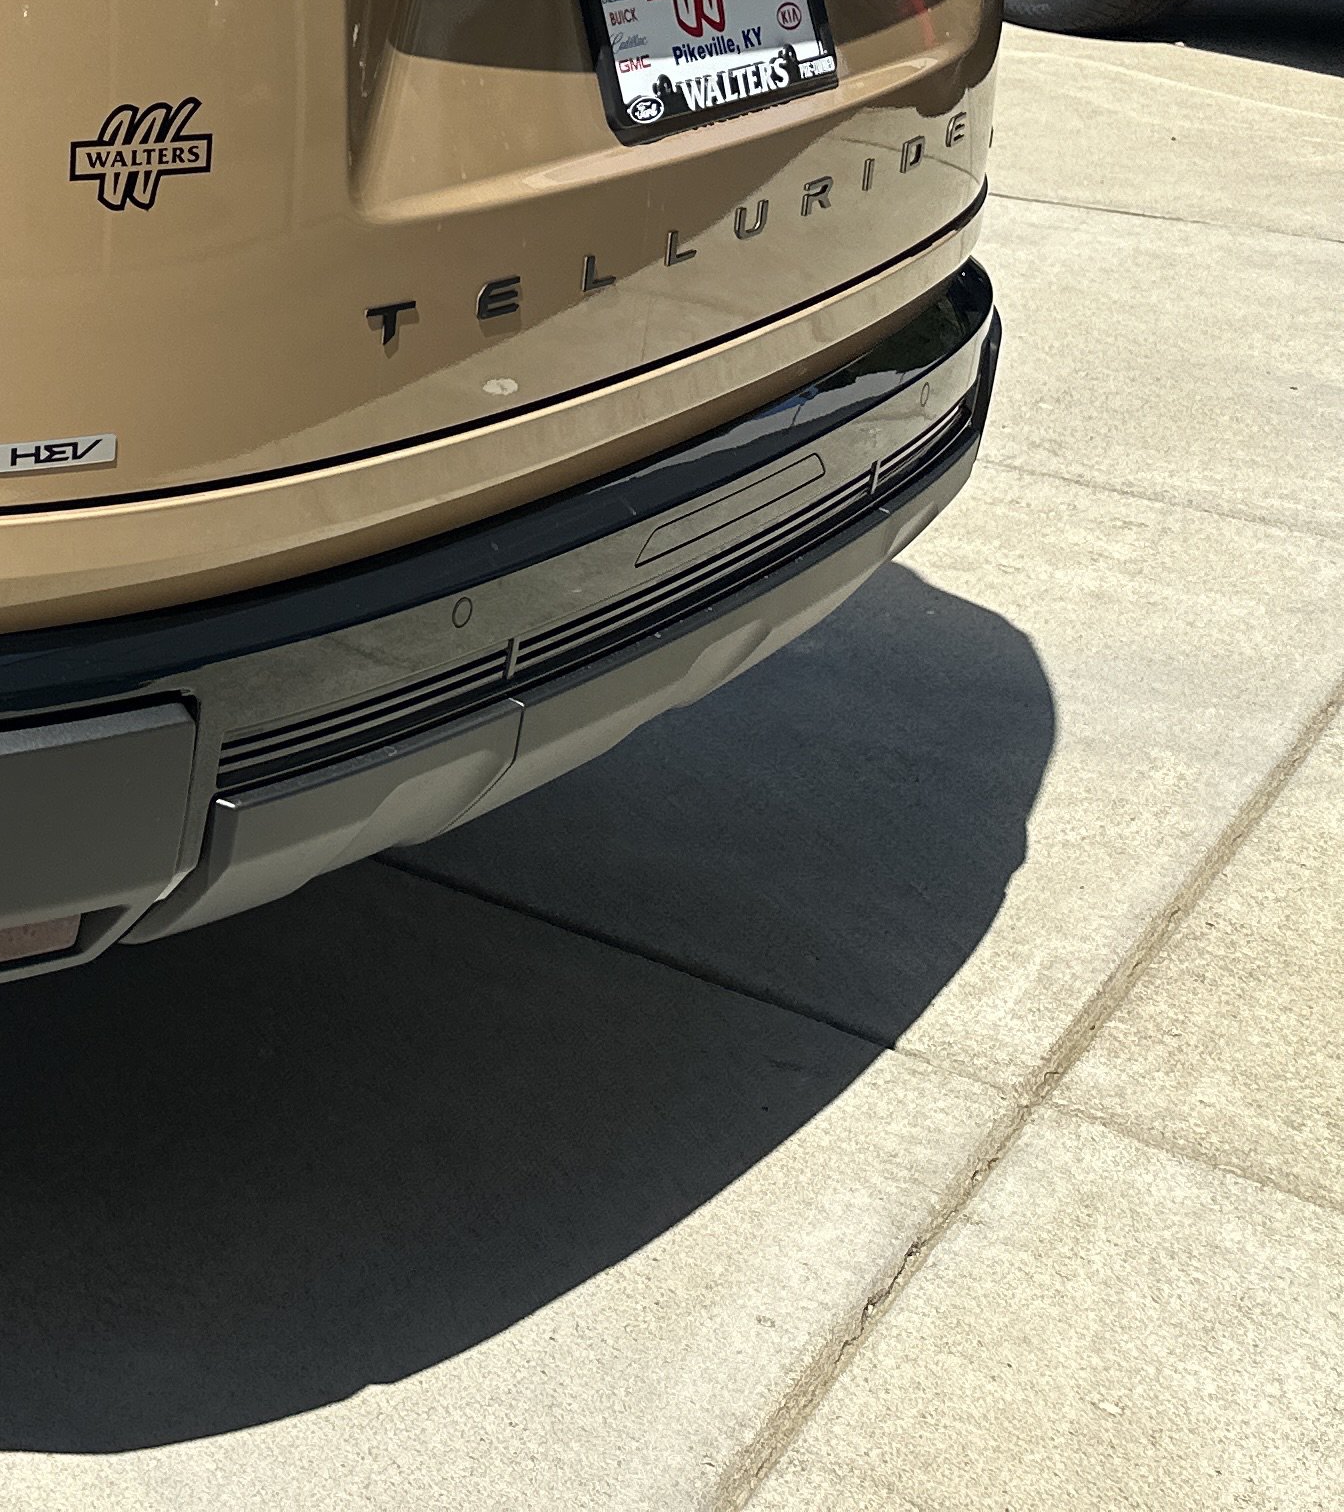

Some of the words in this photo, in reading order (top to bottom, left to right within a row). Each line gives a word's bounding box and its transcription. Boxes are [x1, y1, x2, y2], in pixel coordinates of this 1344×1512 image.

[609, 7, 639, 26] BUICK
[779, 5, 800, 28] KIA
[672, 35, 741, 66] Pikeville,
[741, 26, 762, 50] KY
[618, 53, 652, 74] GMC
[679, 58, 790, 112] WALTERS
[85, 144, 200, 169] WALTERS
[364, 111, 969, 347] TELLURIDE
[10, 438, 104, 468] HEV
